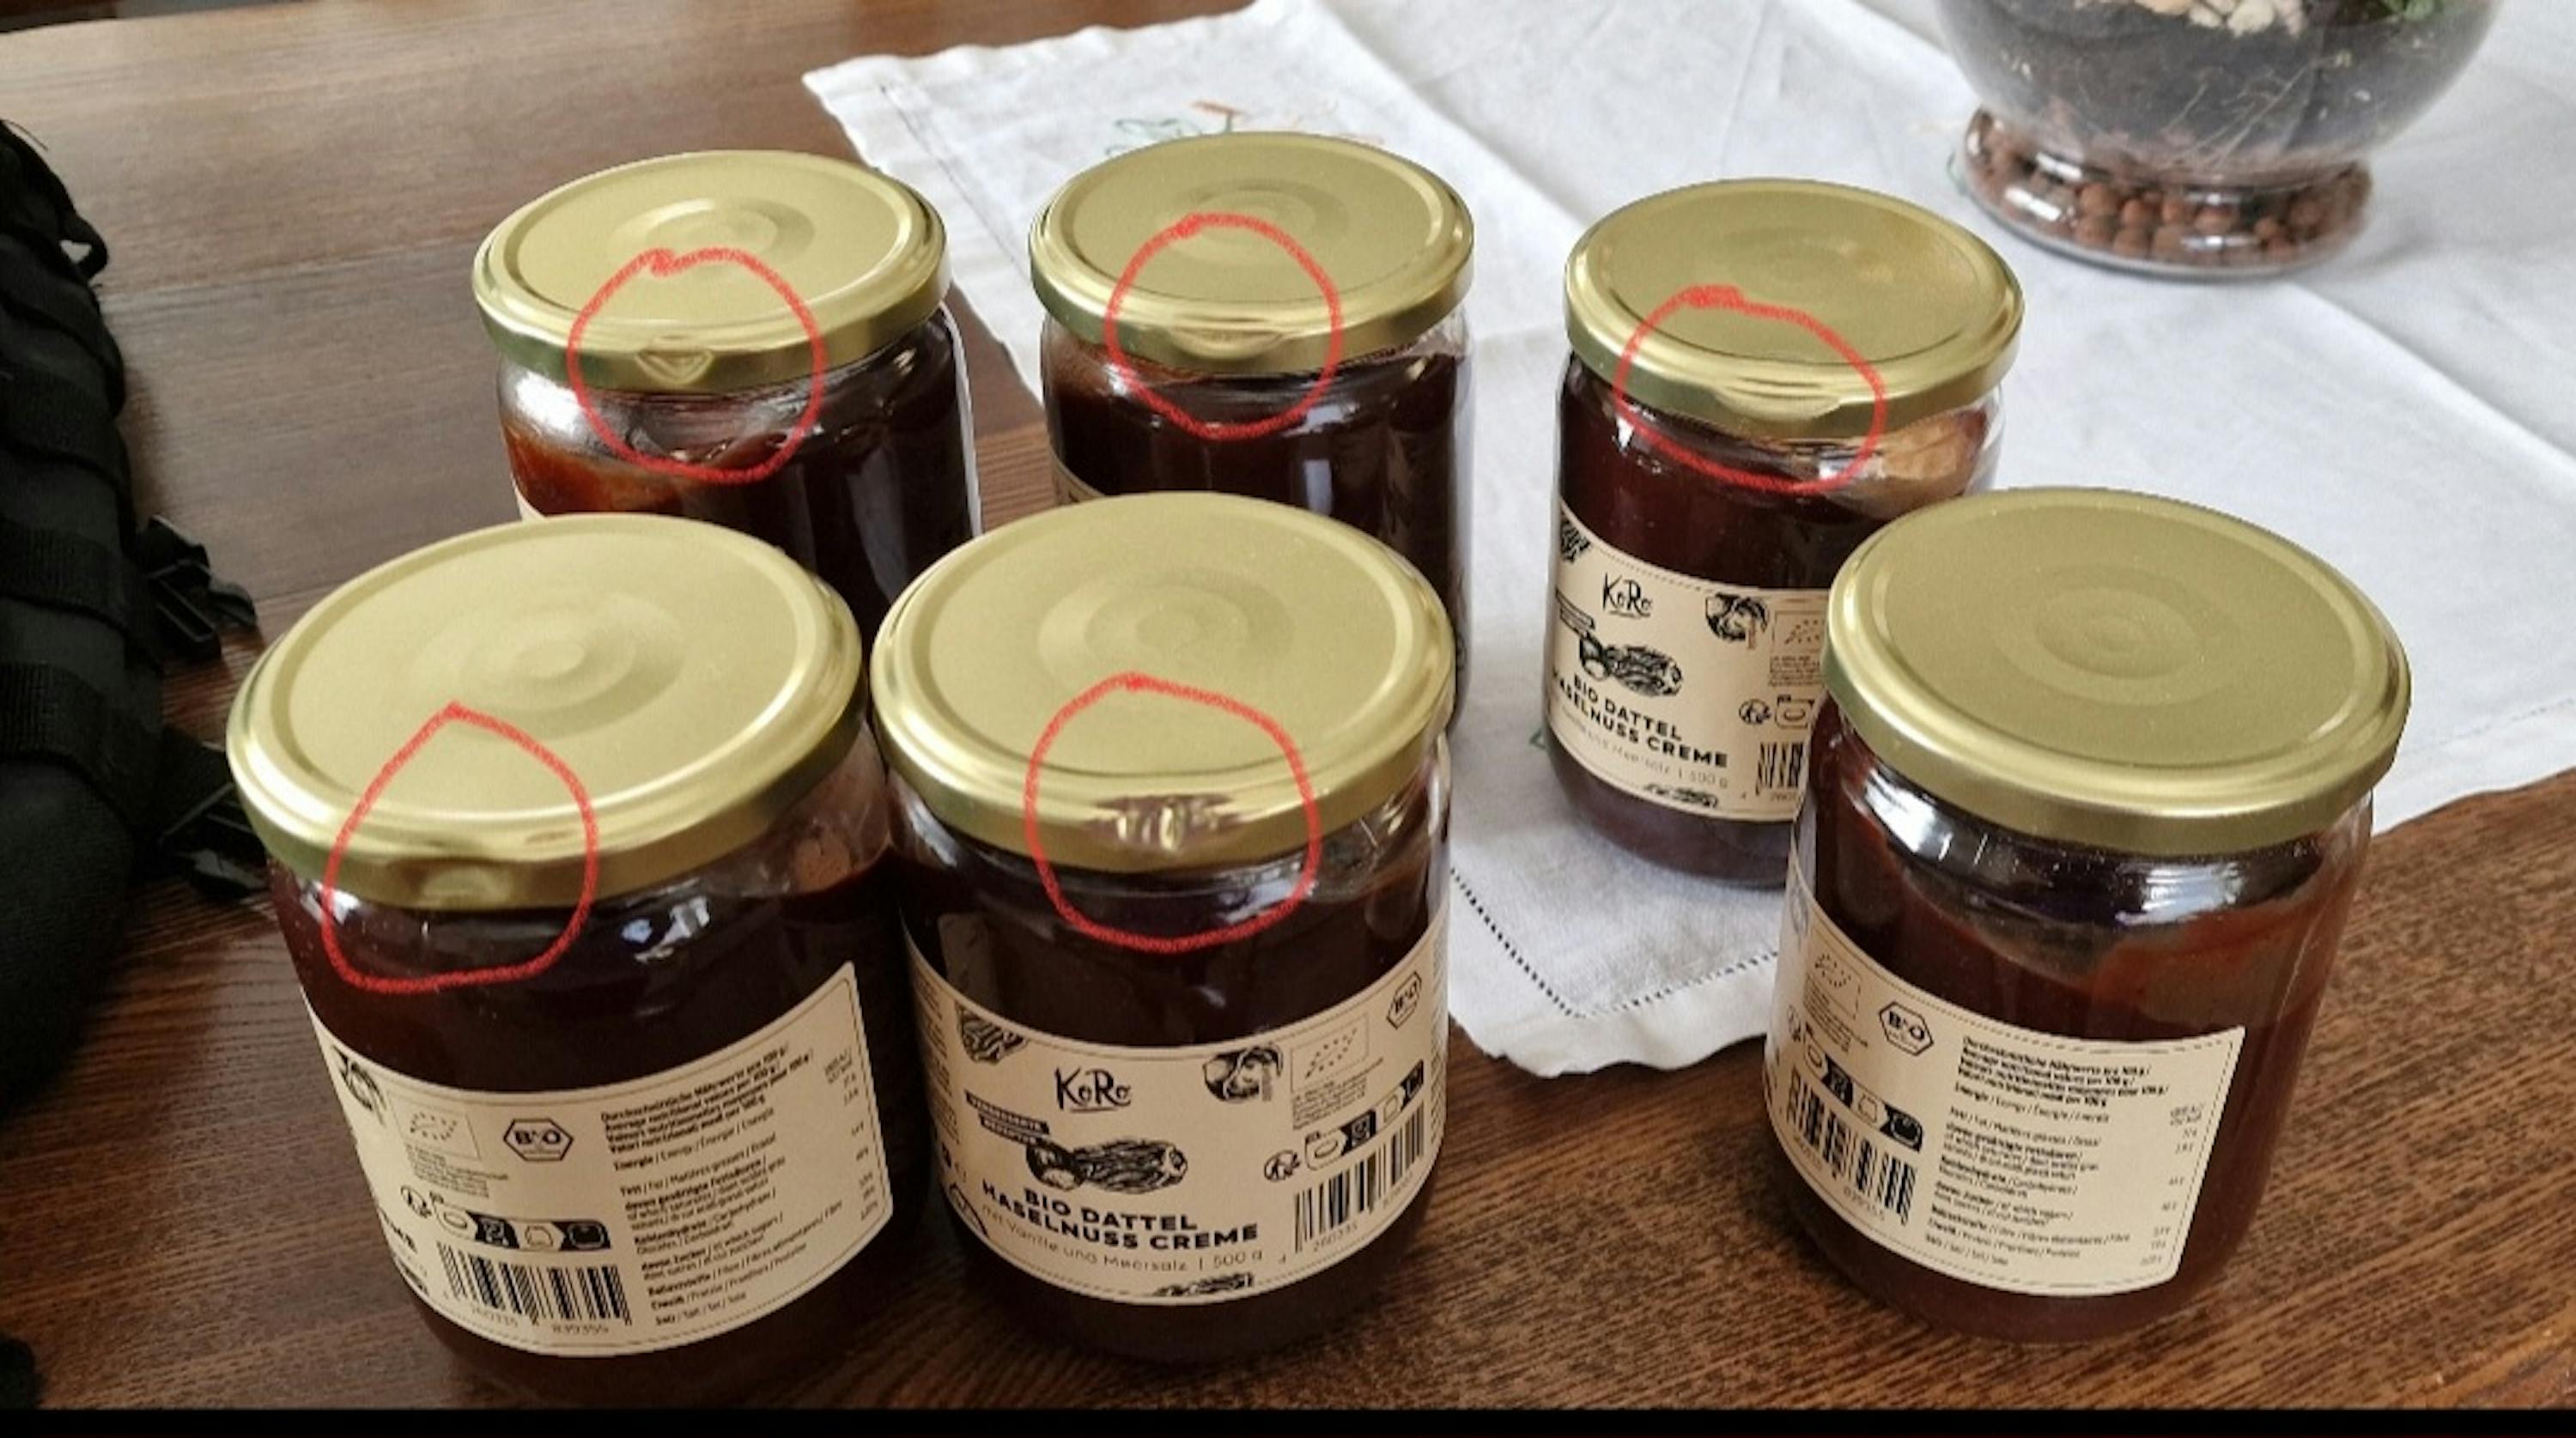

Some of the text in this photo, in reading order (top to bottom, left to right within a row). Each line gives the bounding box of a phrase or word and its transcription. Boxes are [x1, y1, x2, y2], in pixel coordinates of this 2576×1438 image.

[1602, 572, 1653, 619] KoRo
[1574, 673, 1598, 703] BIO
[1604, 696, 1681, 742] DATTEL
[1646, 737, 1728, 768] CREME
[1054, 1066, 1133, 1113] KoRo
[981, 1178, 1139, 1251] HASELNUSS
[1148, 1223, 1259, 1251] CREME
[1024, 1186, 1199, 1232] BIO DATTEL
[1064, 1246, 1098, 1265] und
[1103, 1255, 1188, 1272] Meersalz
[1212, 1252, 1247, 1270] 500
